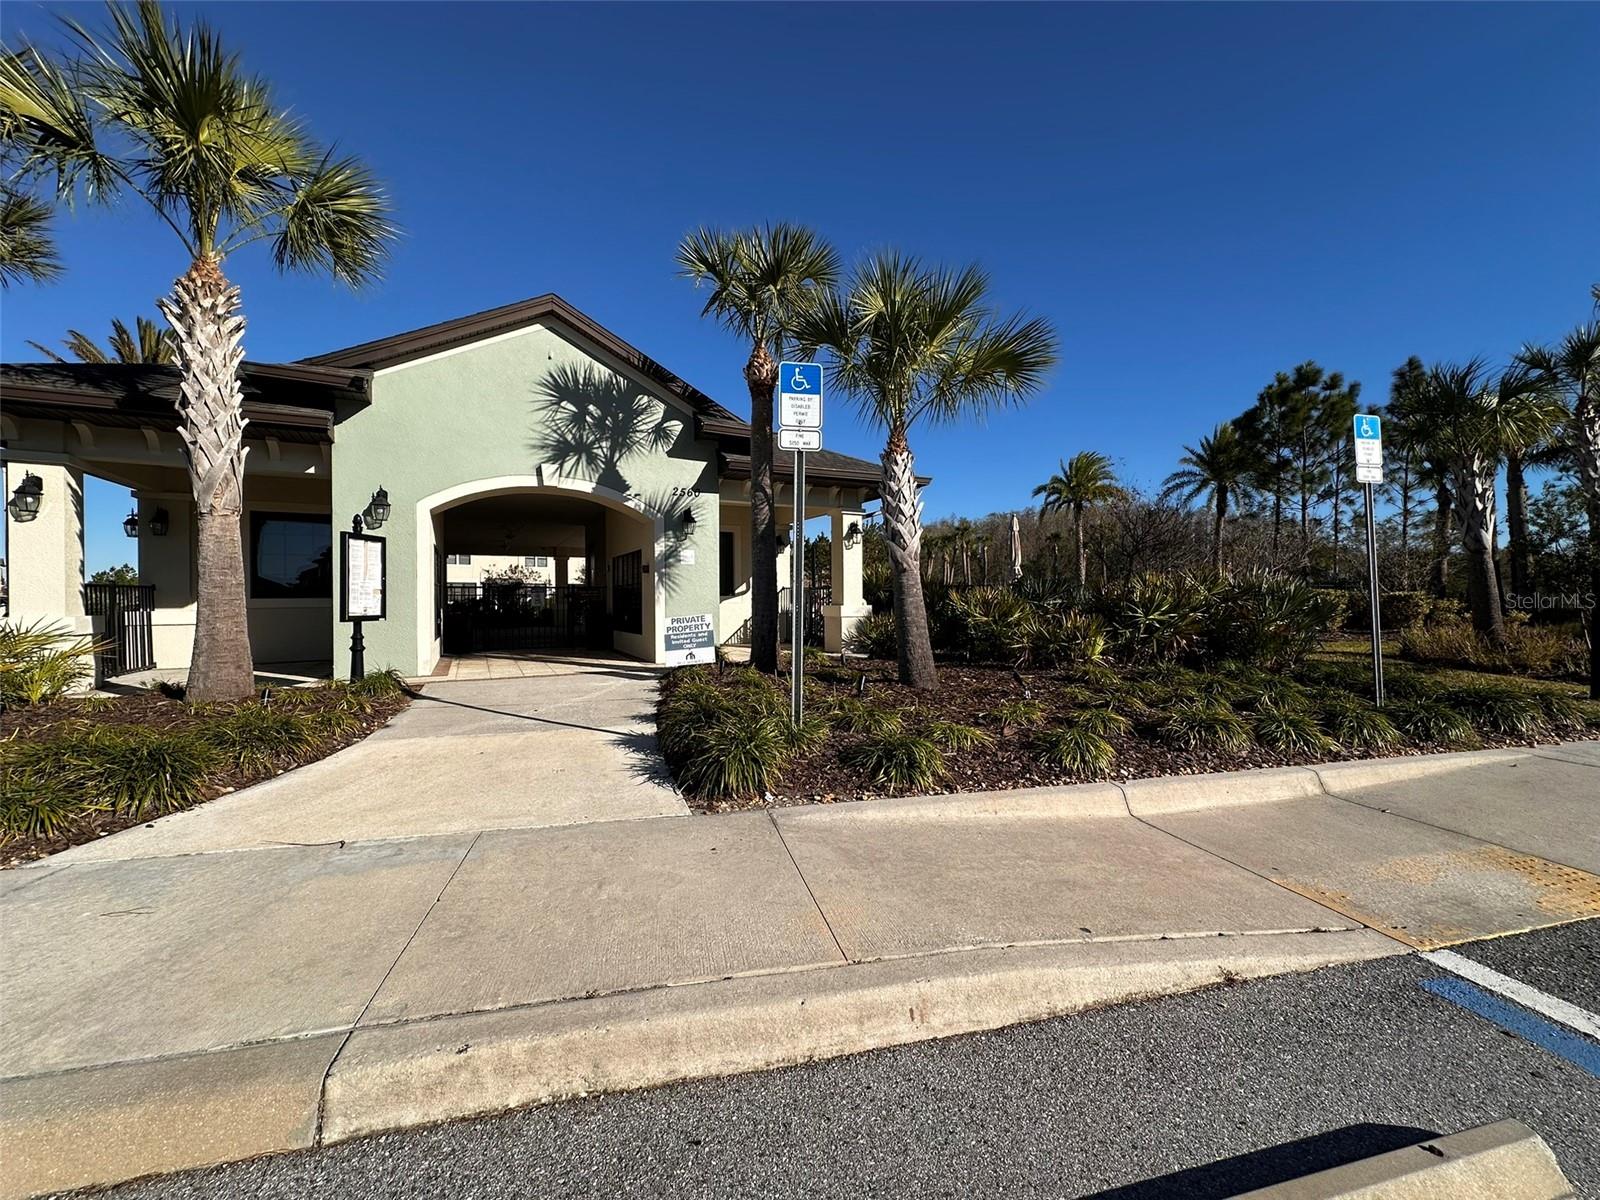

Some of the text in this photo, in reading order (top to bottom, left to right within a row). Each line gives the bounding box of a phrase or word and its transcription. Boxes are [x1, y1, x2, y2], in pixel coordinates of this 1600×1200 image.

[672, 487, 701, 498] 2560
[671, 615, 706, 625] PRIVATE
[666, 622, 711, 633] PROPERTY
